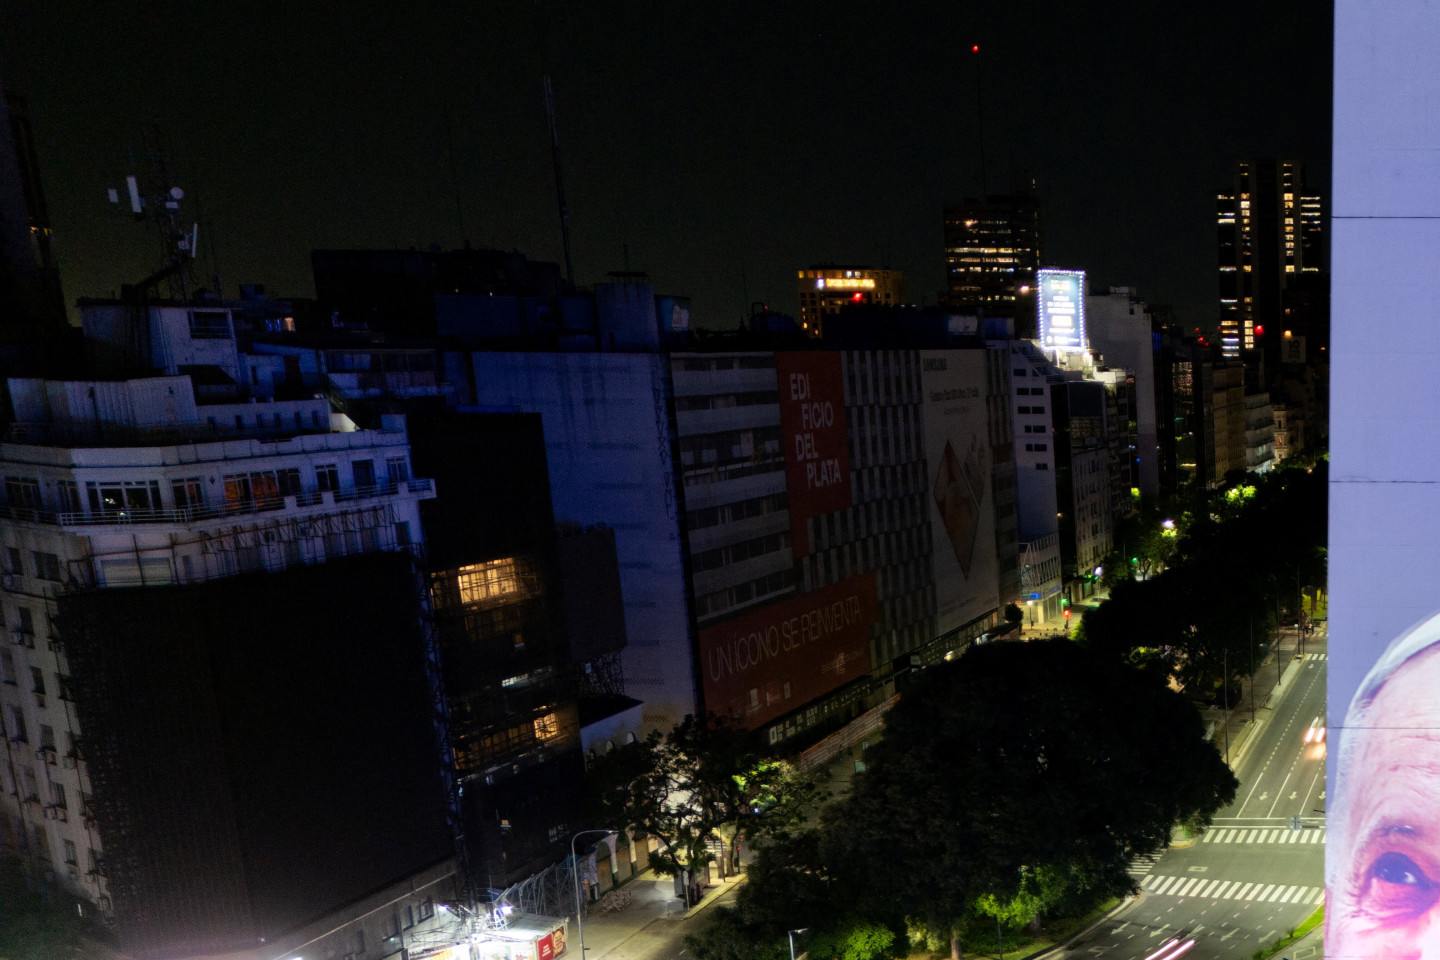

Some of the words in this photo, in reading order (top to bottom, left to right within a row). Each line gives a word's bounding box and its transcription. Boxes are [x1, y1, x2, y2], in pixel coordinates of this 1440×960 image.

[789, 372, 811, 400] EDI
[800, 401, 834, 430] FICIO
[794, 432, 819, 461] DEL
[806, 457, 843, 489] PLATA
[782, 617, 800, 652] SE
